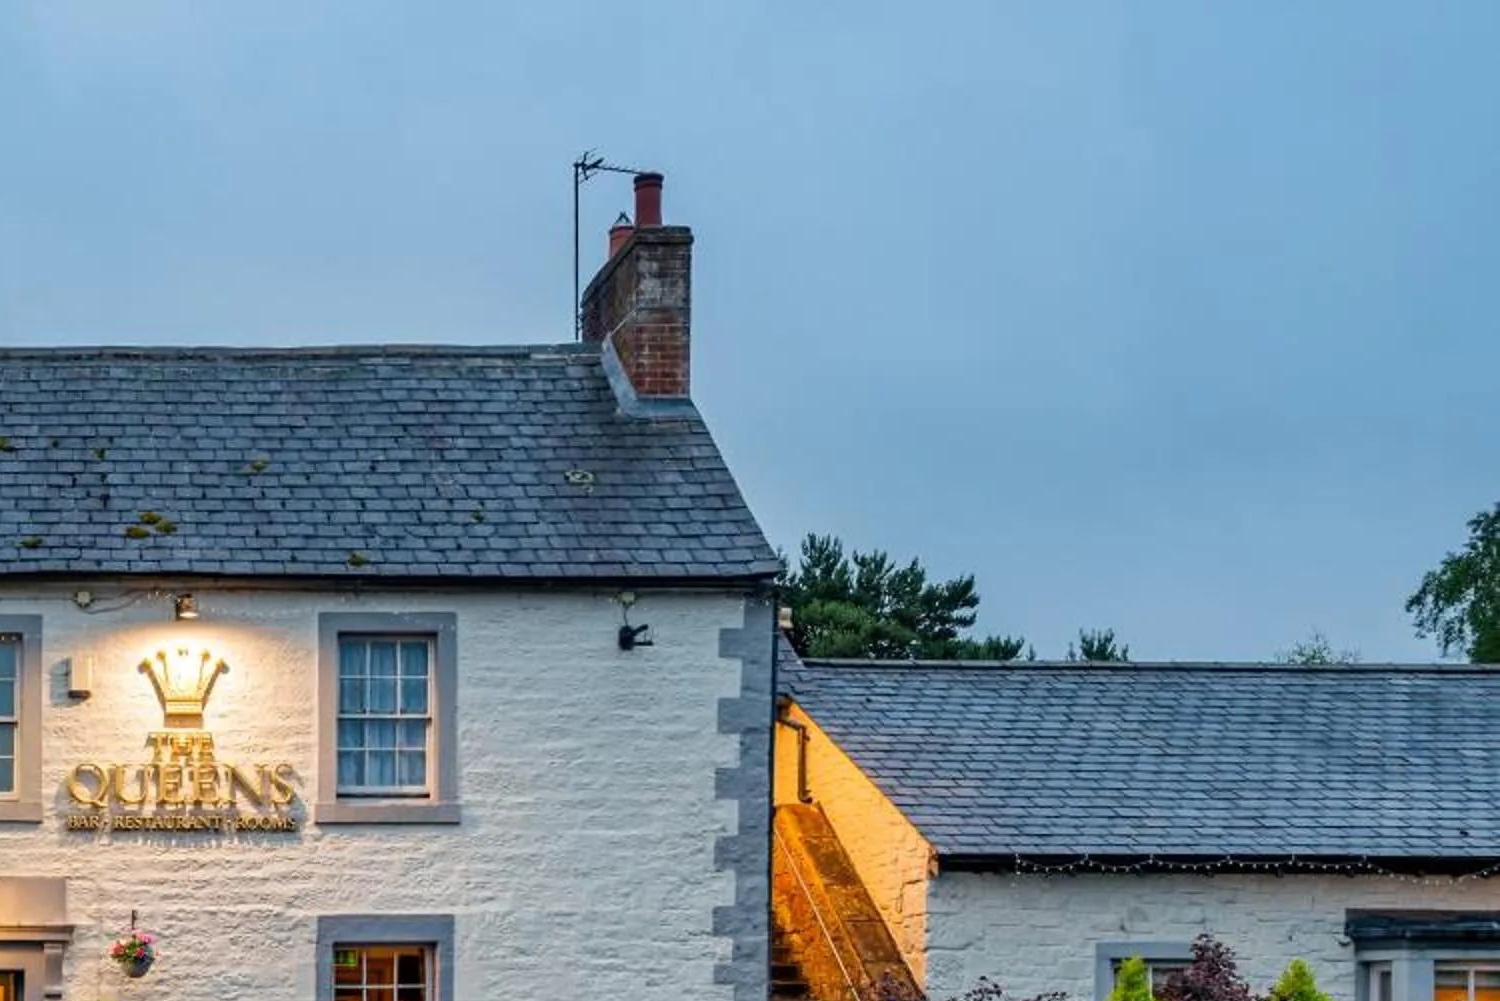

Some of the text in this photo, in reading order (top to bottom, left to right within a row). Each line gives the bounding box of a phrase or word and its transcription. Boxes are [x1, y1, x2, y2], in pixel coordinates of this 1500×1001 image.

[147, 731, 215, 765] THE
[67, 763, 295, 807] QUEENS
[114, 815, 222, 831] RESTAURANT
[235, 815, 296, 831] ROOMS
